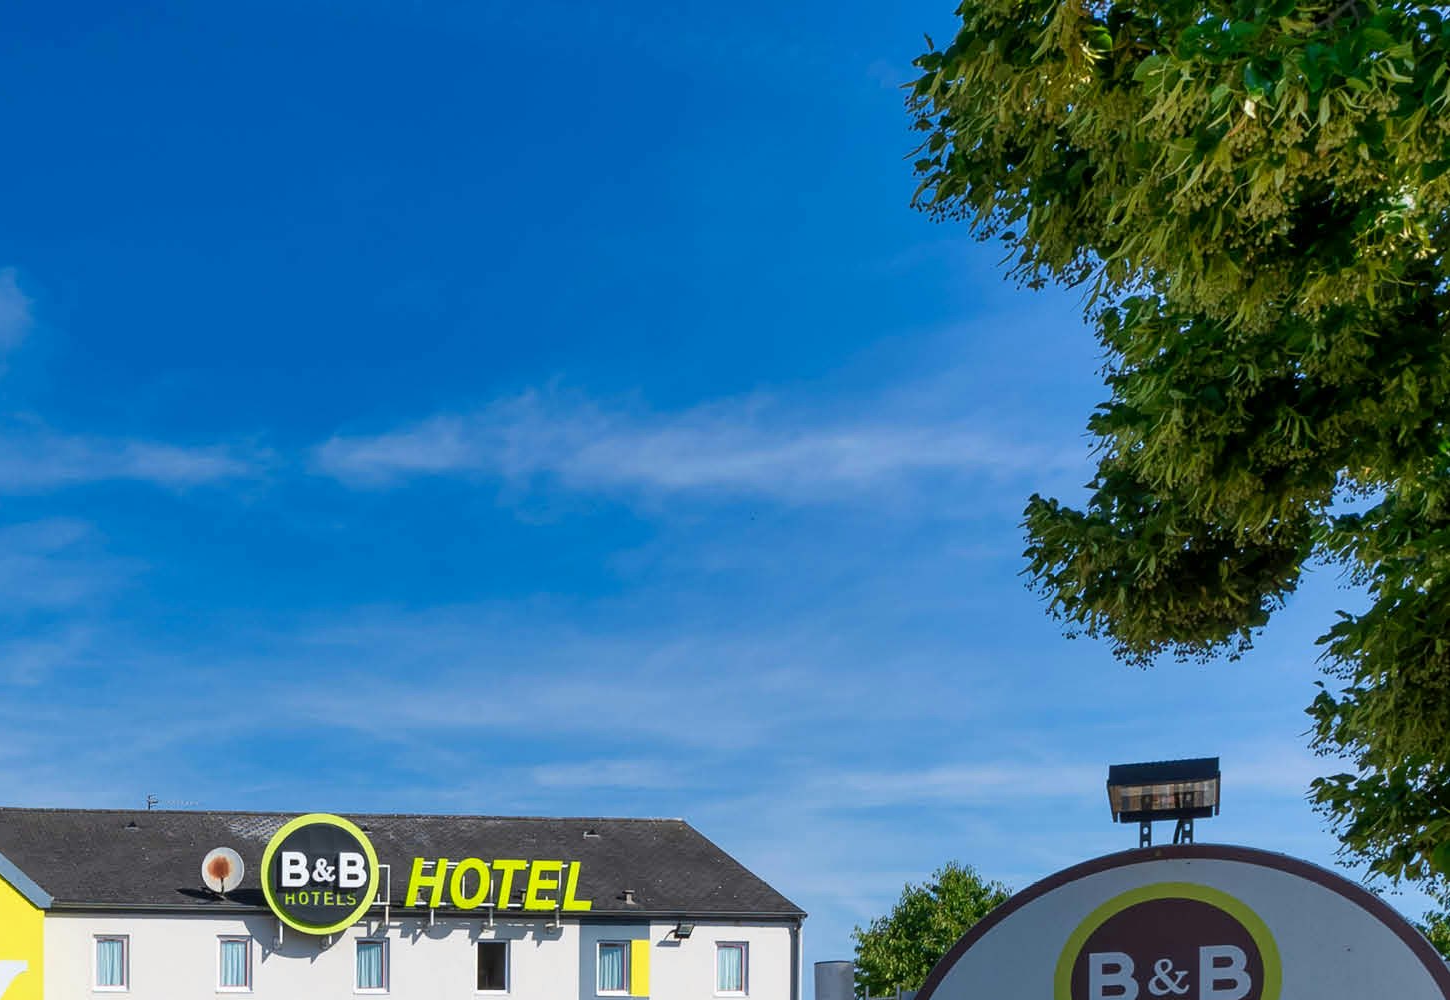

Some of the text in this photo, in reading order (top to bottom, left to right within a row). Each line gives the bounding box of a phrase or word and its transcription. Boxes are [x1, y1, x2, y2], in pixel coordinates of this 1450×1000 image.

[281, 851, 367, 888] B&B
[404, 857, 593, 911] HOTEL
[285, 892, 357, 906] HOTELS
